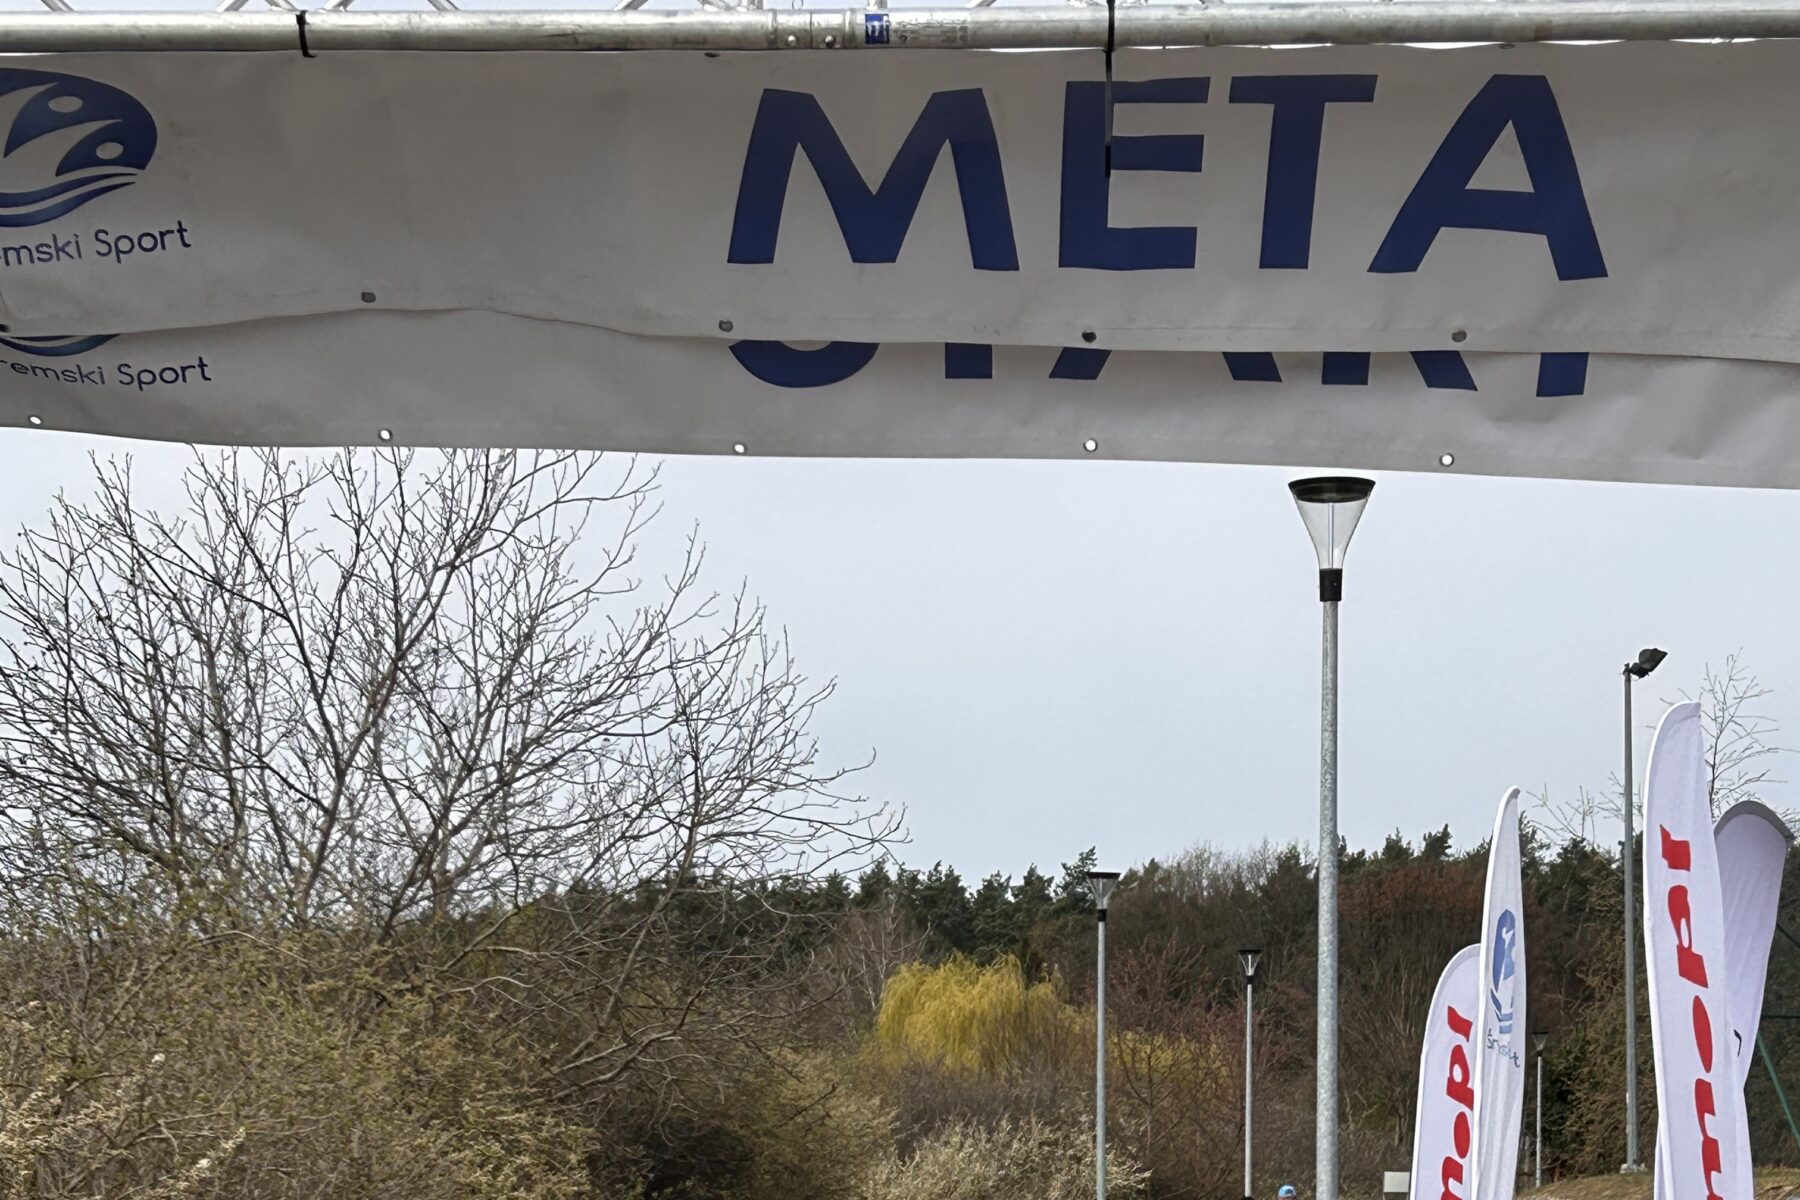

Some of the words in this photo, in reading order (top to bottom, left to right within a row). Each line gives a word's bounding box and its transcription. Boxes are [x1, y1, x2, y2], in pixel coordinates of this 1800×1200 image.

[728, 73, 1608, 281] META
[0, 233, 82, 267] mski
[94, 220, 192, 264] Sport
[117, 355, 212, 392] Sport
